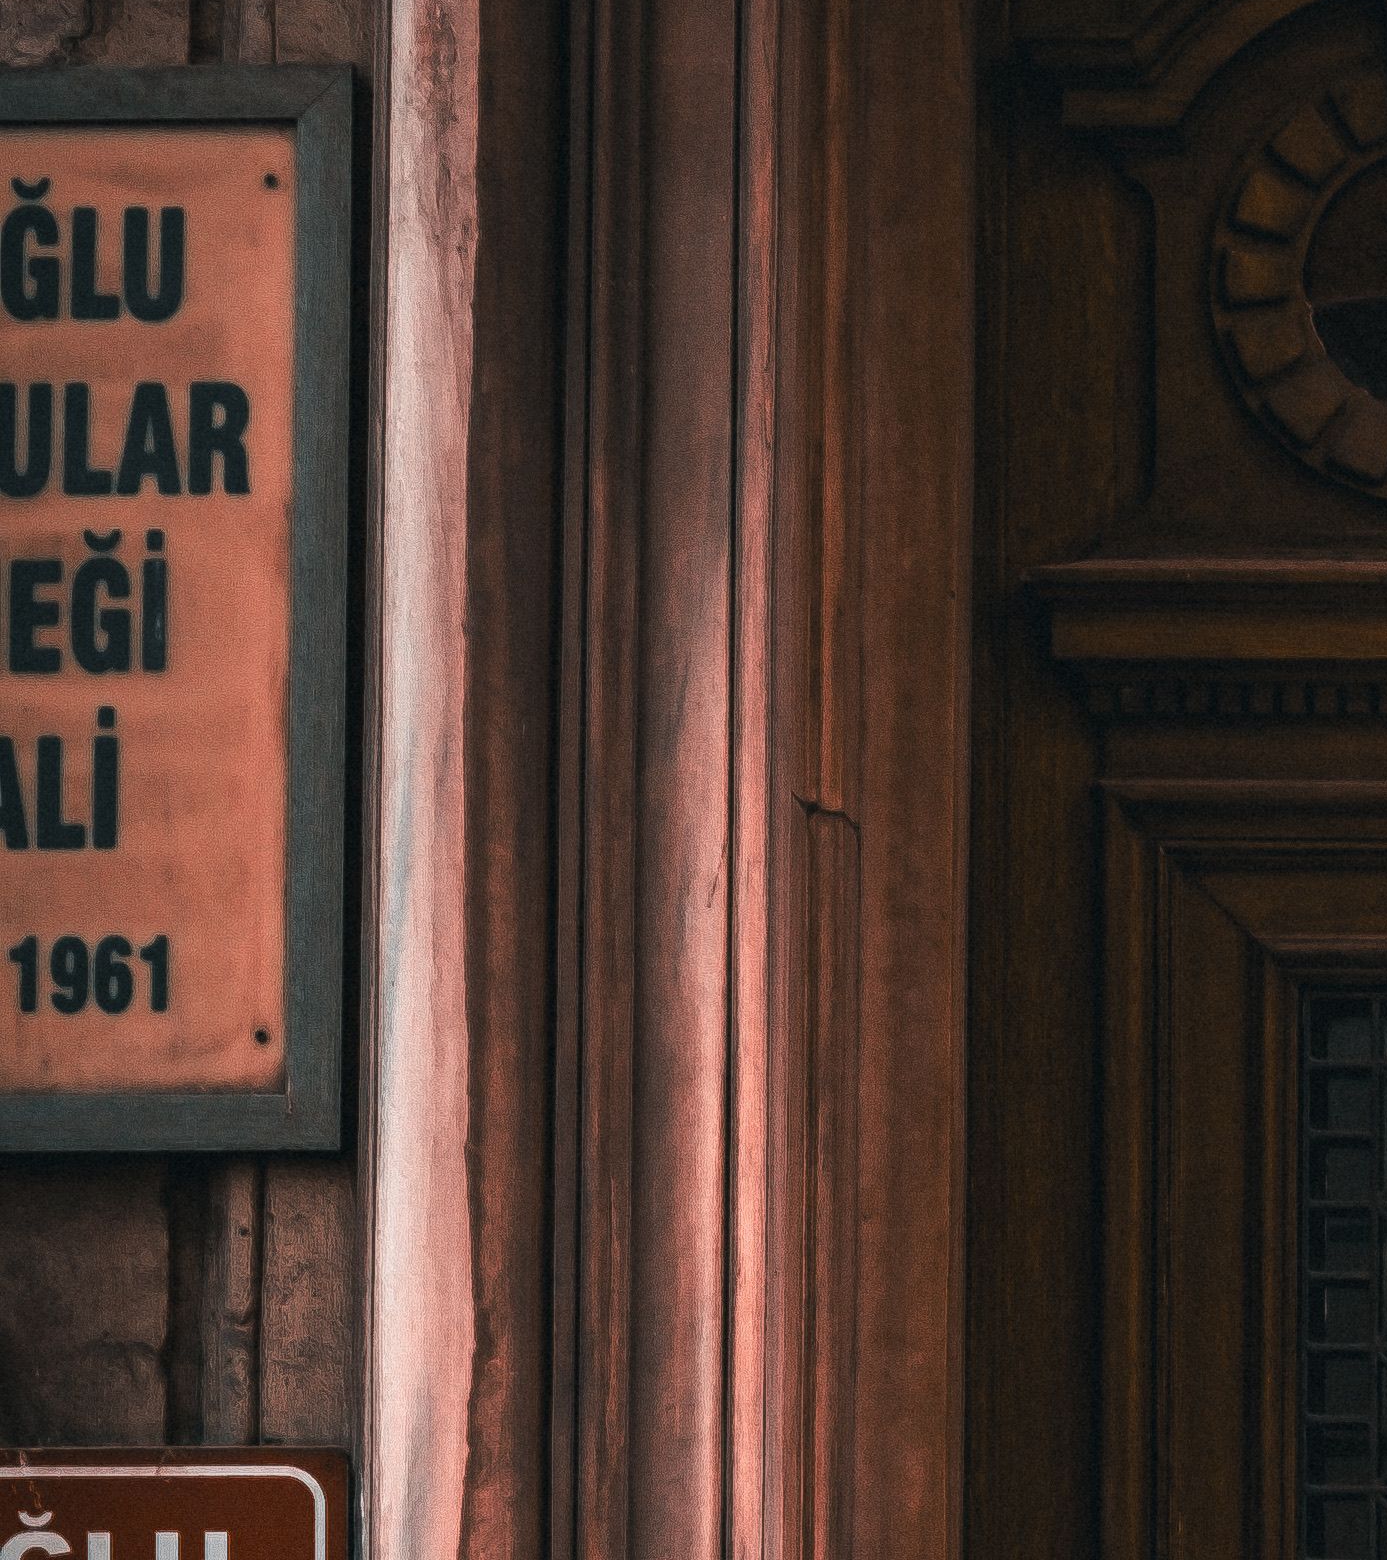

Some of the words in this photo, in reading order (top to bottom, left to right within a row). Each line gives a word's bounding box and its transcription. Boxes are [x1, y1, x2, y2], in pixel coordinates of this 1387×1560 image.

[0, 176, 187, 322] ĞLU
[0, 381, 251, 499] ULAR
[8, 933, 170, 1017] 1961
